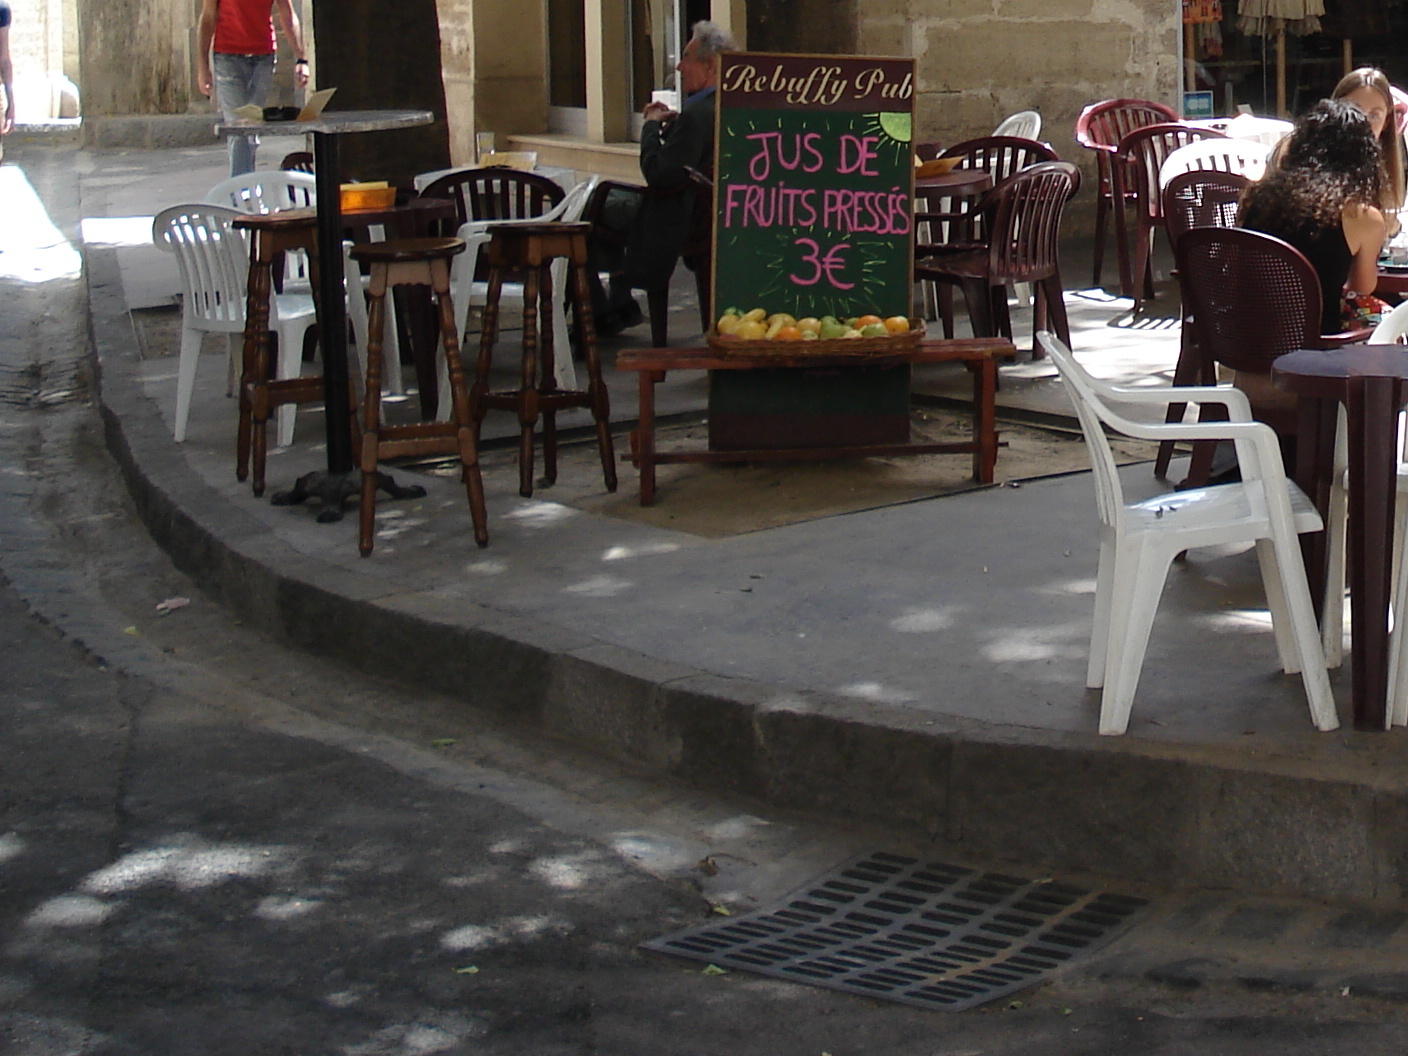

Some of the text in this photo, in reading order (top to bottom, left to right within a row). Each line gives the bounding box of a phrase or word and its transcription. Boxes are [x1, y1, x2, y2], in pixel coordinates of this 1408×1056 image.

[722, 64, 913, 105] Rebuffy Pub
[746, 132, 879, 181] JUS DE
[724, 181, 817, 228] FRUITS
[789, 237, 855, 290] 3€
